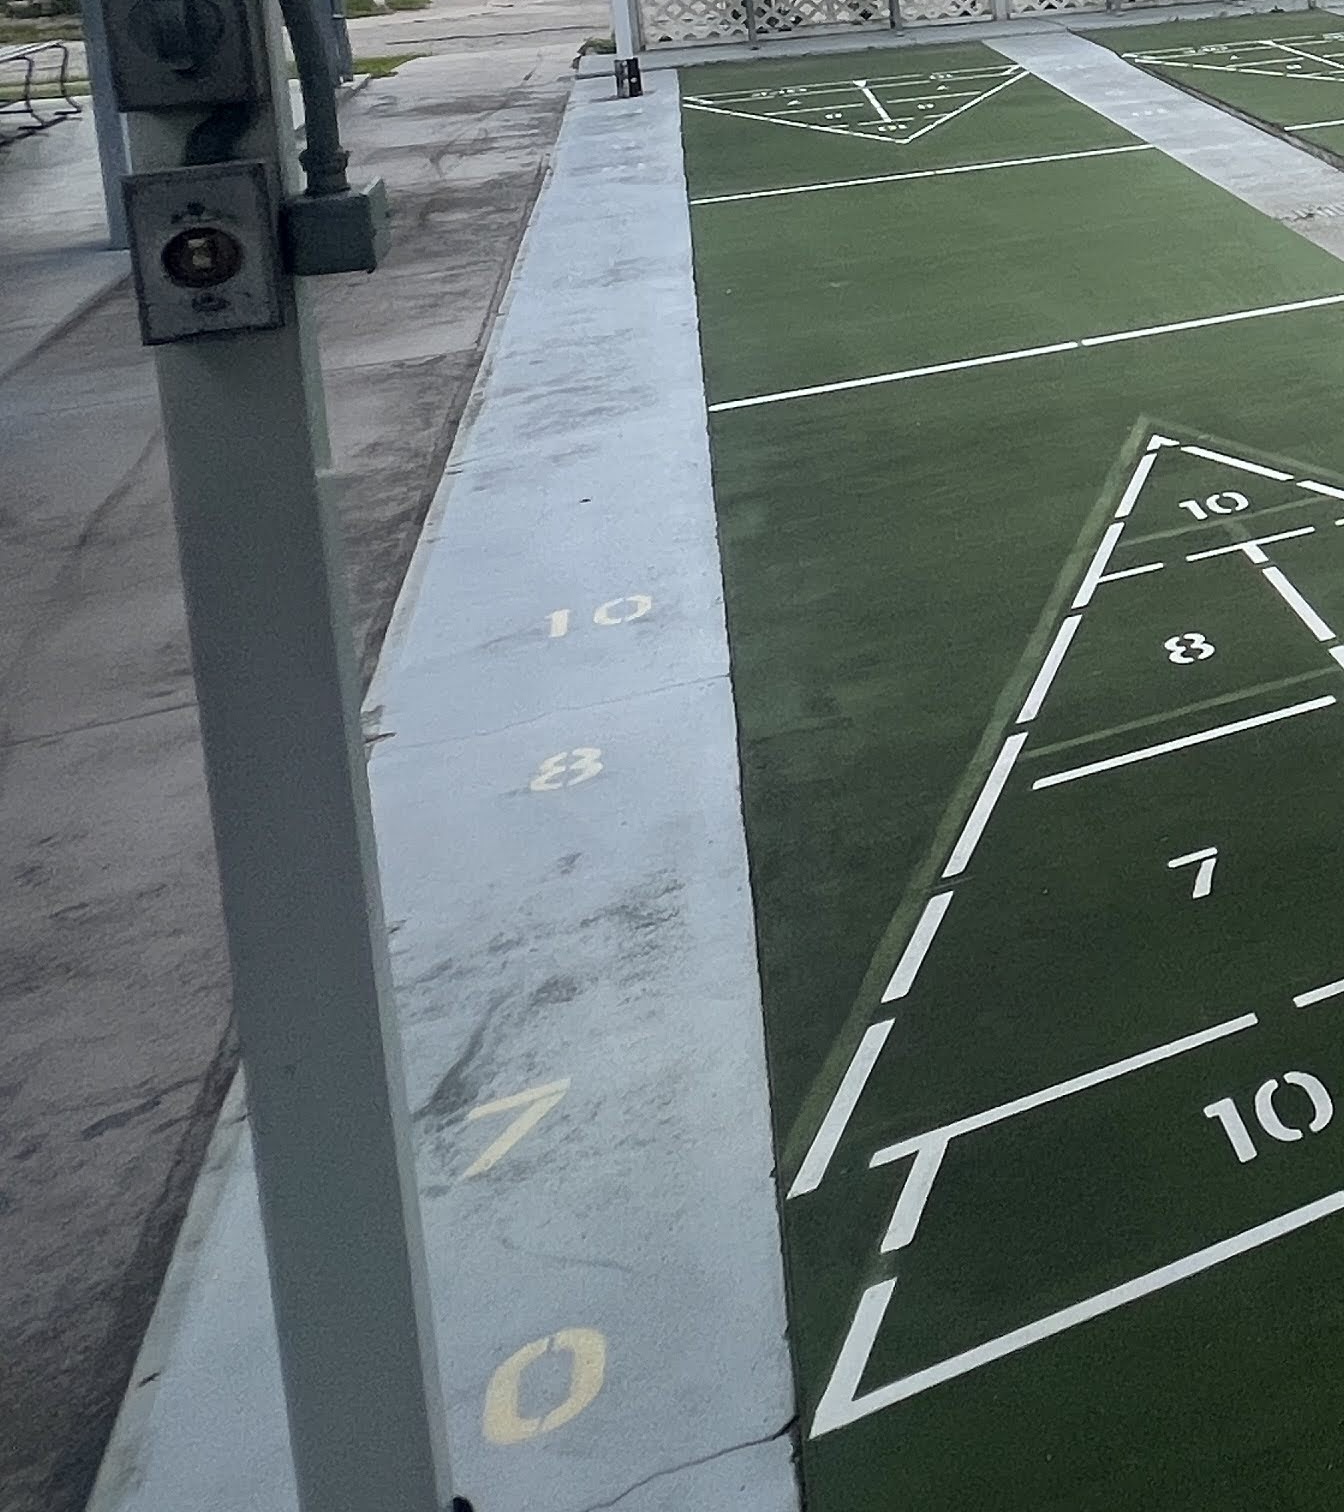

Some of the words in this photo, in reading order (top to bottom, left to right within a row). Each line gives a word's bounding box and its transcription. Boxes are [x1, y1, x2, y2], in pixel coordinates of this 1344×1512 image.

[1179, 491, 1249, 520] 10
[544, 594, 652, 638] 10
[1164, 632, 1215, 664] 8
[528, 746, 604, 792] 8
[1167, 846, 1218, 899] 7
[467, 1078, 573, 1178] 7
[1203, 1071, 1334, 1163] 10
